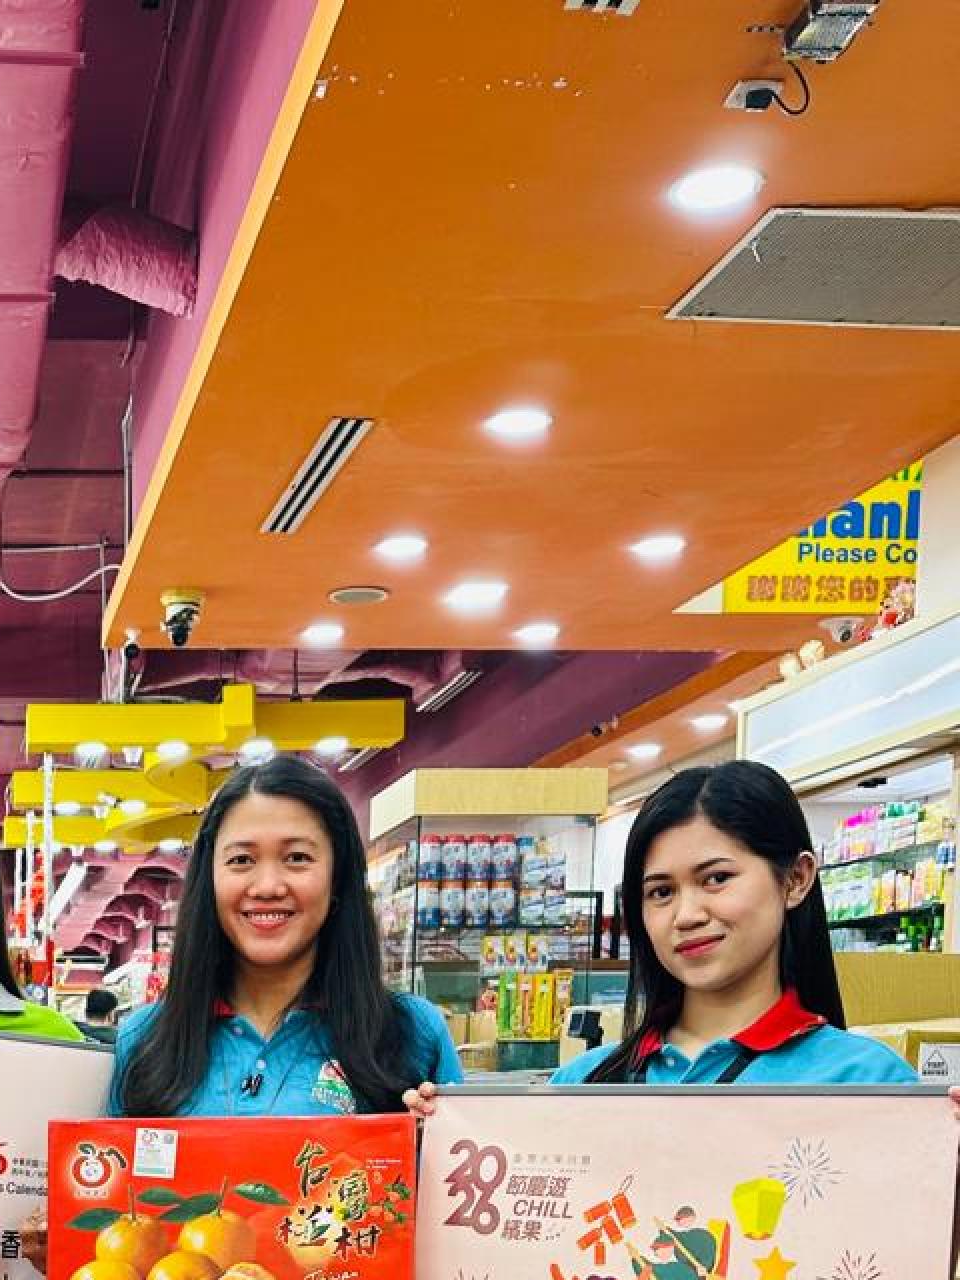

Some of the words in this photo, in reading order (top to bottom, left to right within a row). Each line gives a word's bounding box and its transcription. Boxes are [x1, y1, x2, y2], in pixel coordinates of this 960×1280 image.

[798, 543, 877, 563] Please
[746, 576, 916, 602] 謝謝您的
[513, 1199, 574, 1219] CHILL
